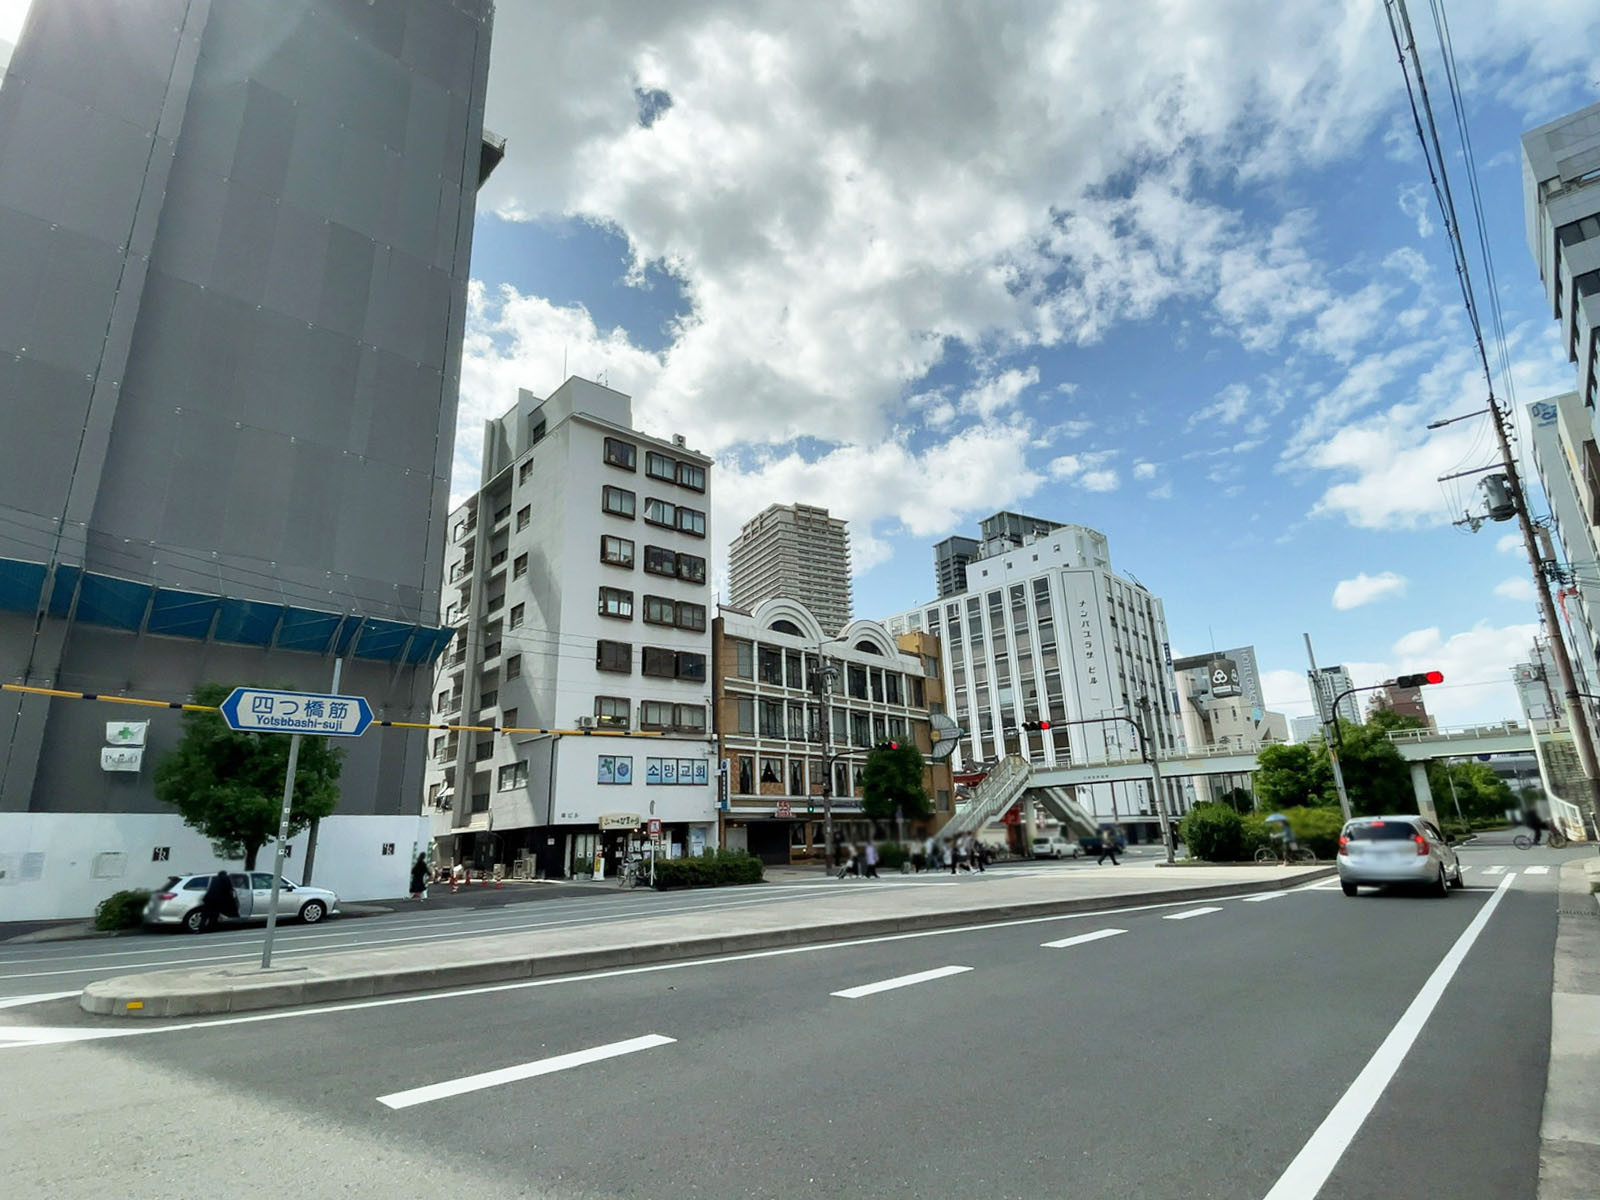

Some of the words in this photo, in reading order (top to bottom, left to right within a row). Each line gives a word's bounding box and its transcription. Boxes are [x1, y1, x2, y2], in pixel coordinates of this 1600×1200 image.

[252, 696, 349, 719] 四つ橋筋
[256, 714, 343, 731] Yotsubashi-suji
[647, 764, 706, 779] 소망교회
